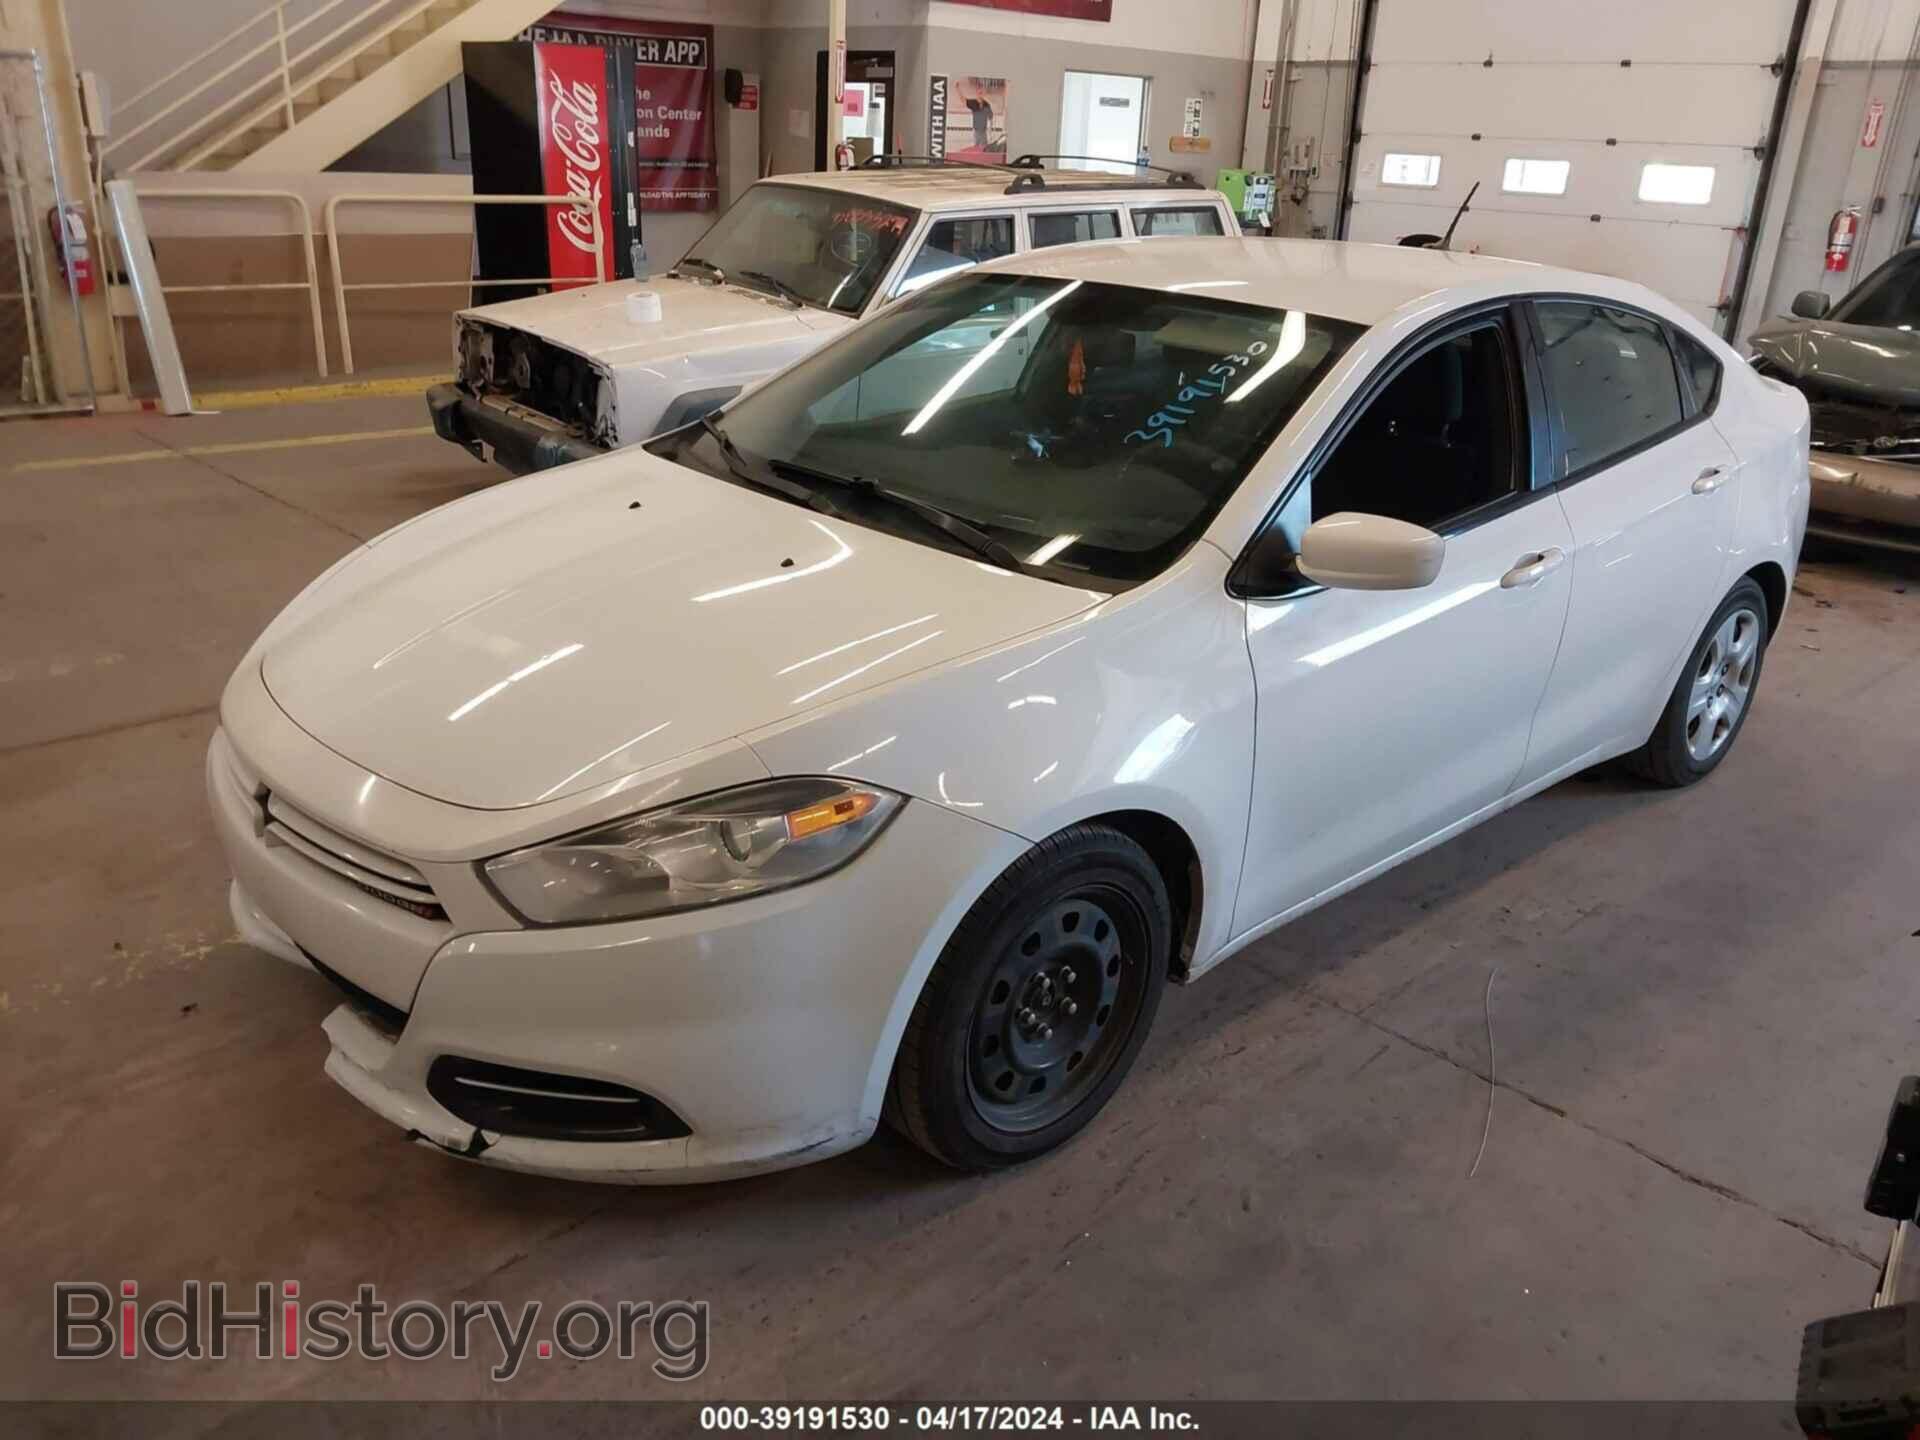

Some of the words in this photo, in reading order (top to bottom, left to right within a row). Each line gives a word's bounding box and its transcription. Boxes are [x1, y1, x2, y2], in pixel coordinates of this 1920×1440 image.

[664, 40, 700, 64] APP
[636, 107, 653, 119] on
[657, 105, 702, 120] Center
[933, 80, 945, 110] IAA
[931, 116, 943, 158] WITH
[550, 69, 602, 253] Coca-Cola
[1123, 340, 1268, 449] 39191530
